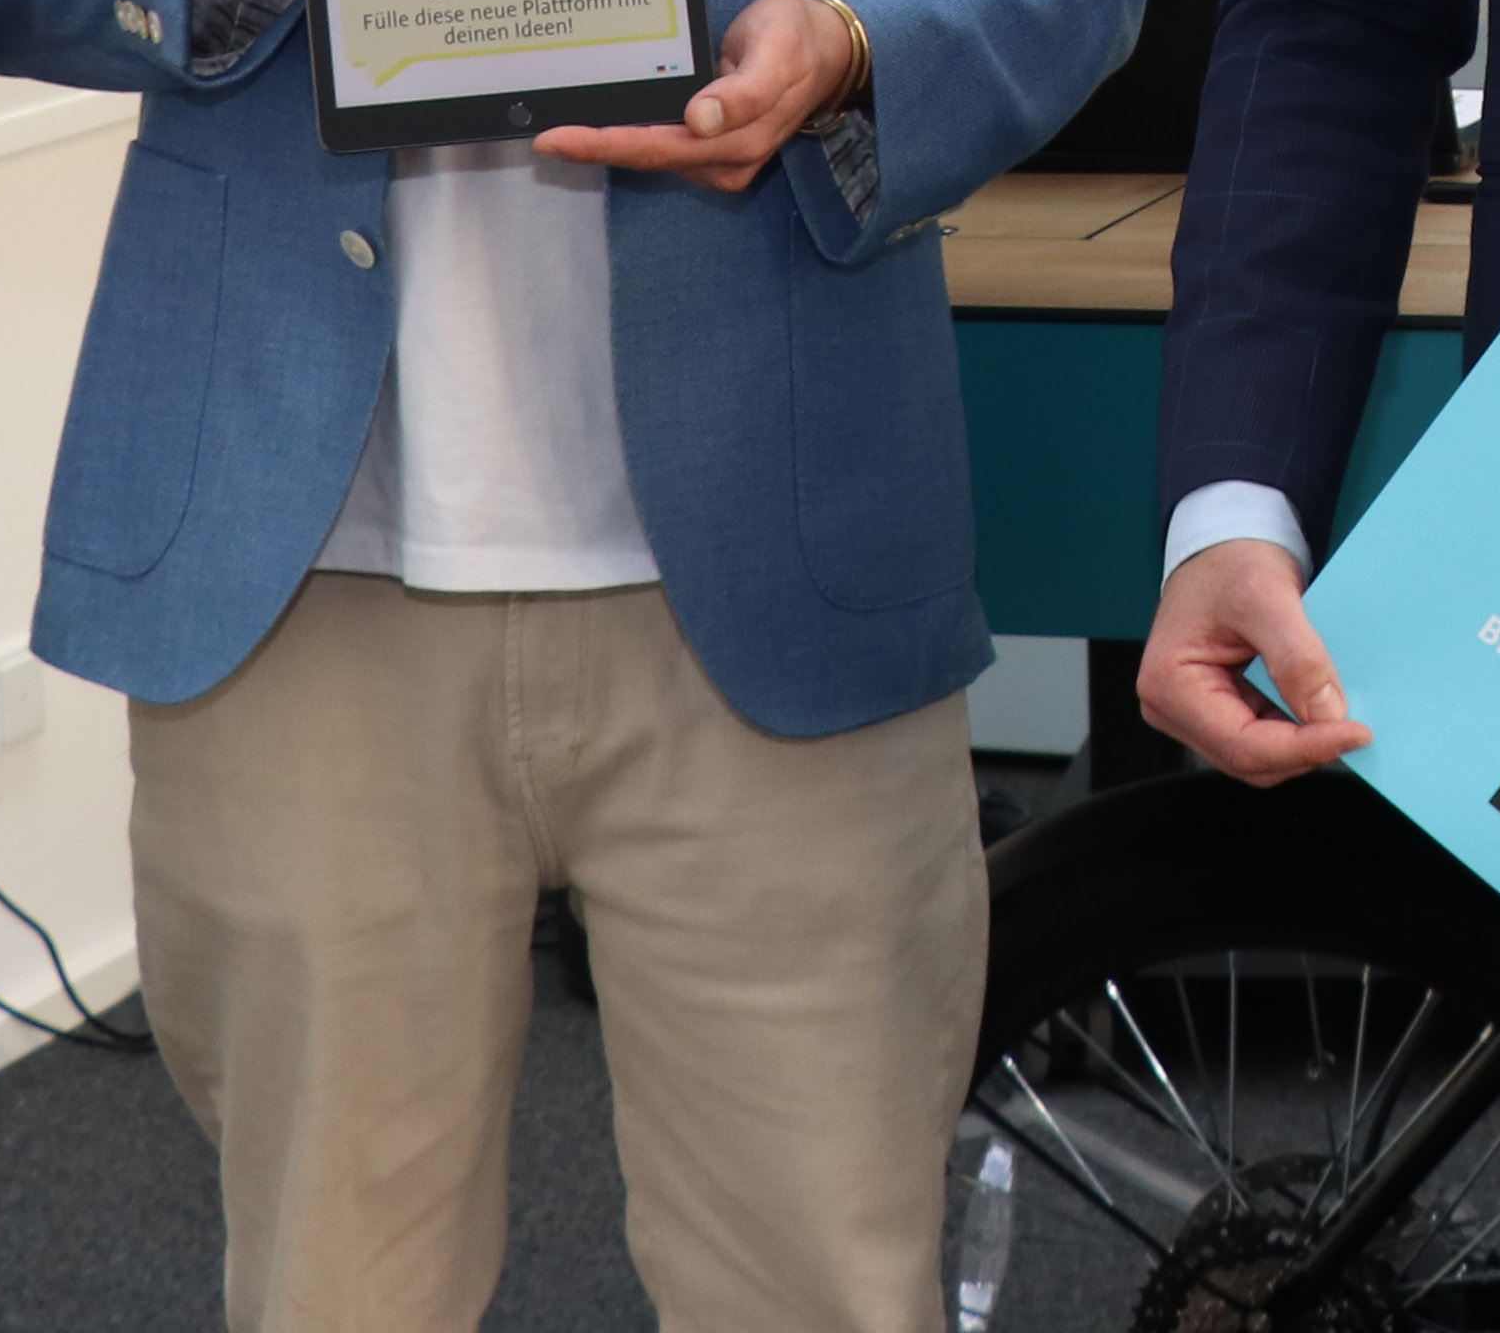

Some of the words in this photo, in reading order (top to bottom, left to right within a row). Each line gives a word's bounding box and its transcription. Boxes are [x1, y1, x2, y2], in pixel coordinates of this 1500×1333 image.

[363, 10, 409, 31] Fülle
[414, 5, 465, 27] diese
[471, 4, 517, 20] neue
[444, 26, 509, 46] deinen
[515, 18, 574, 37] Ideen!
